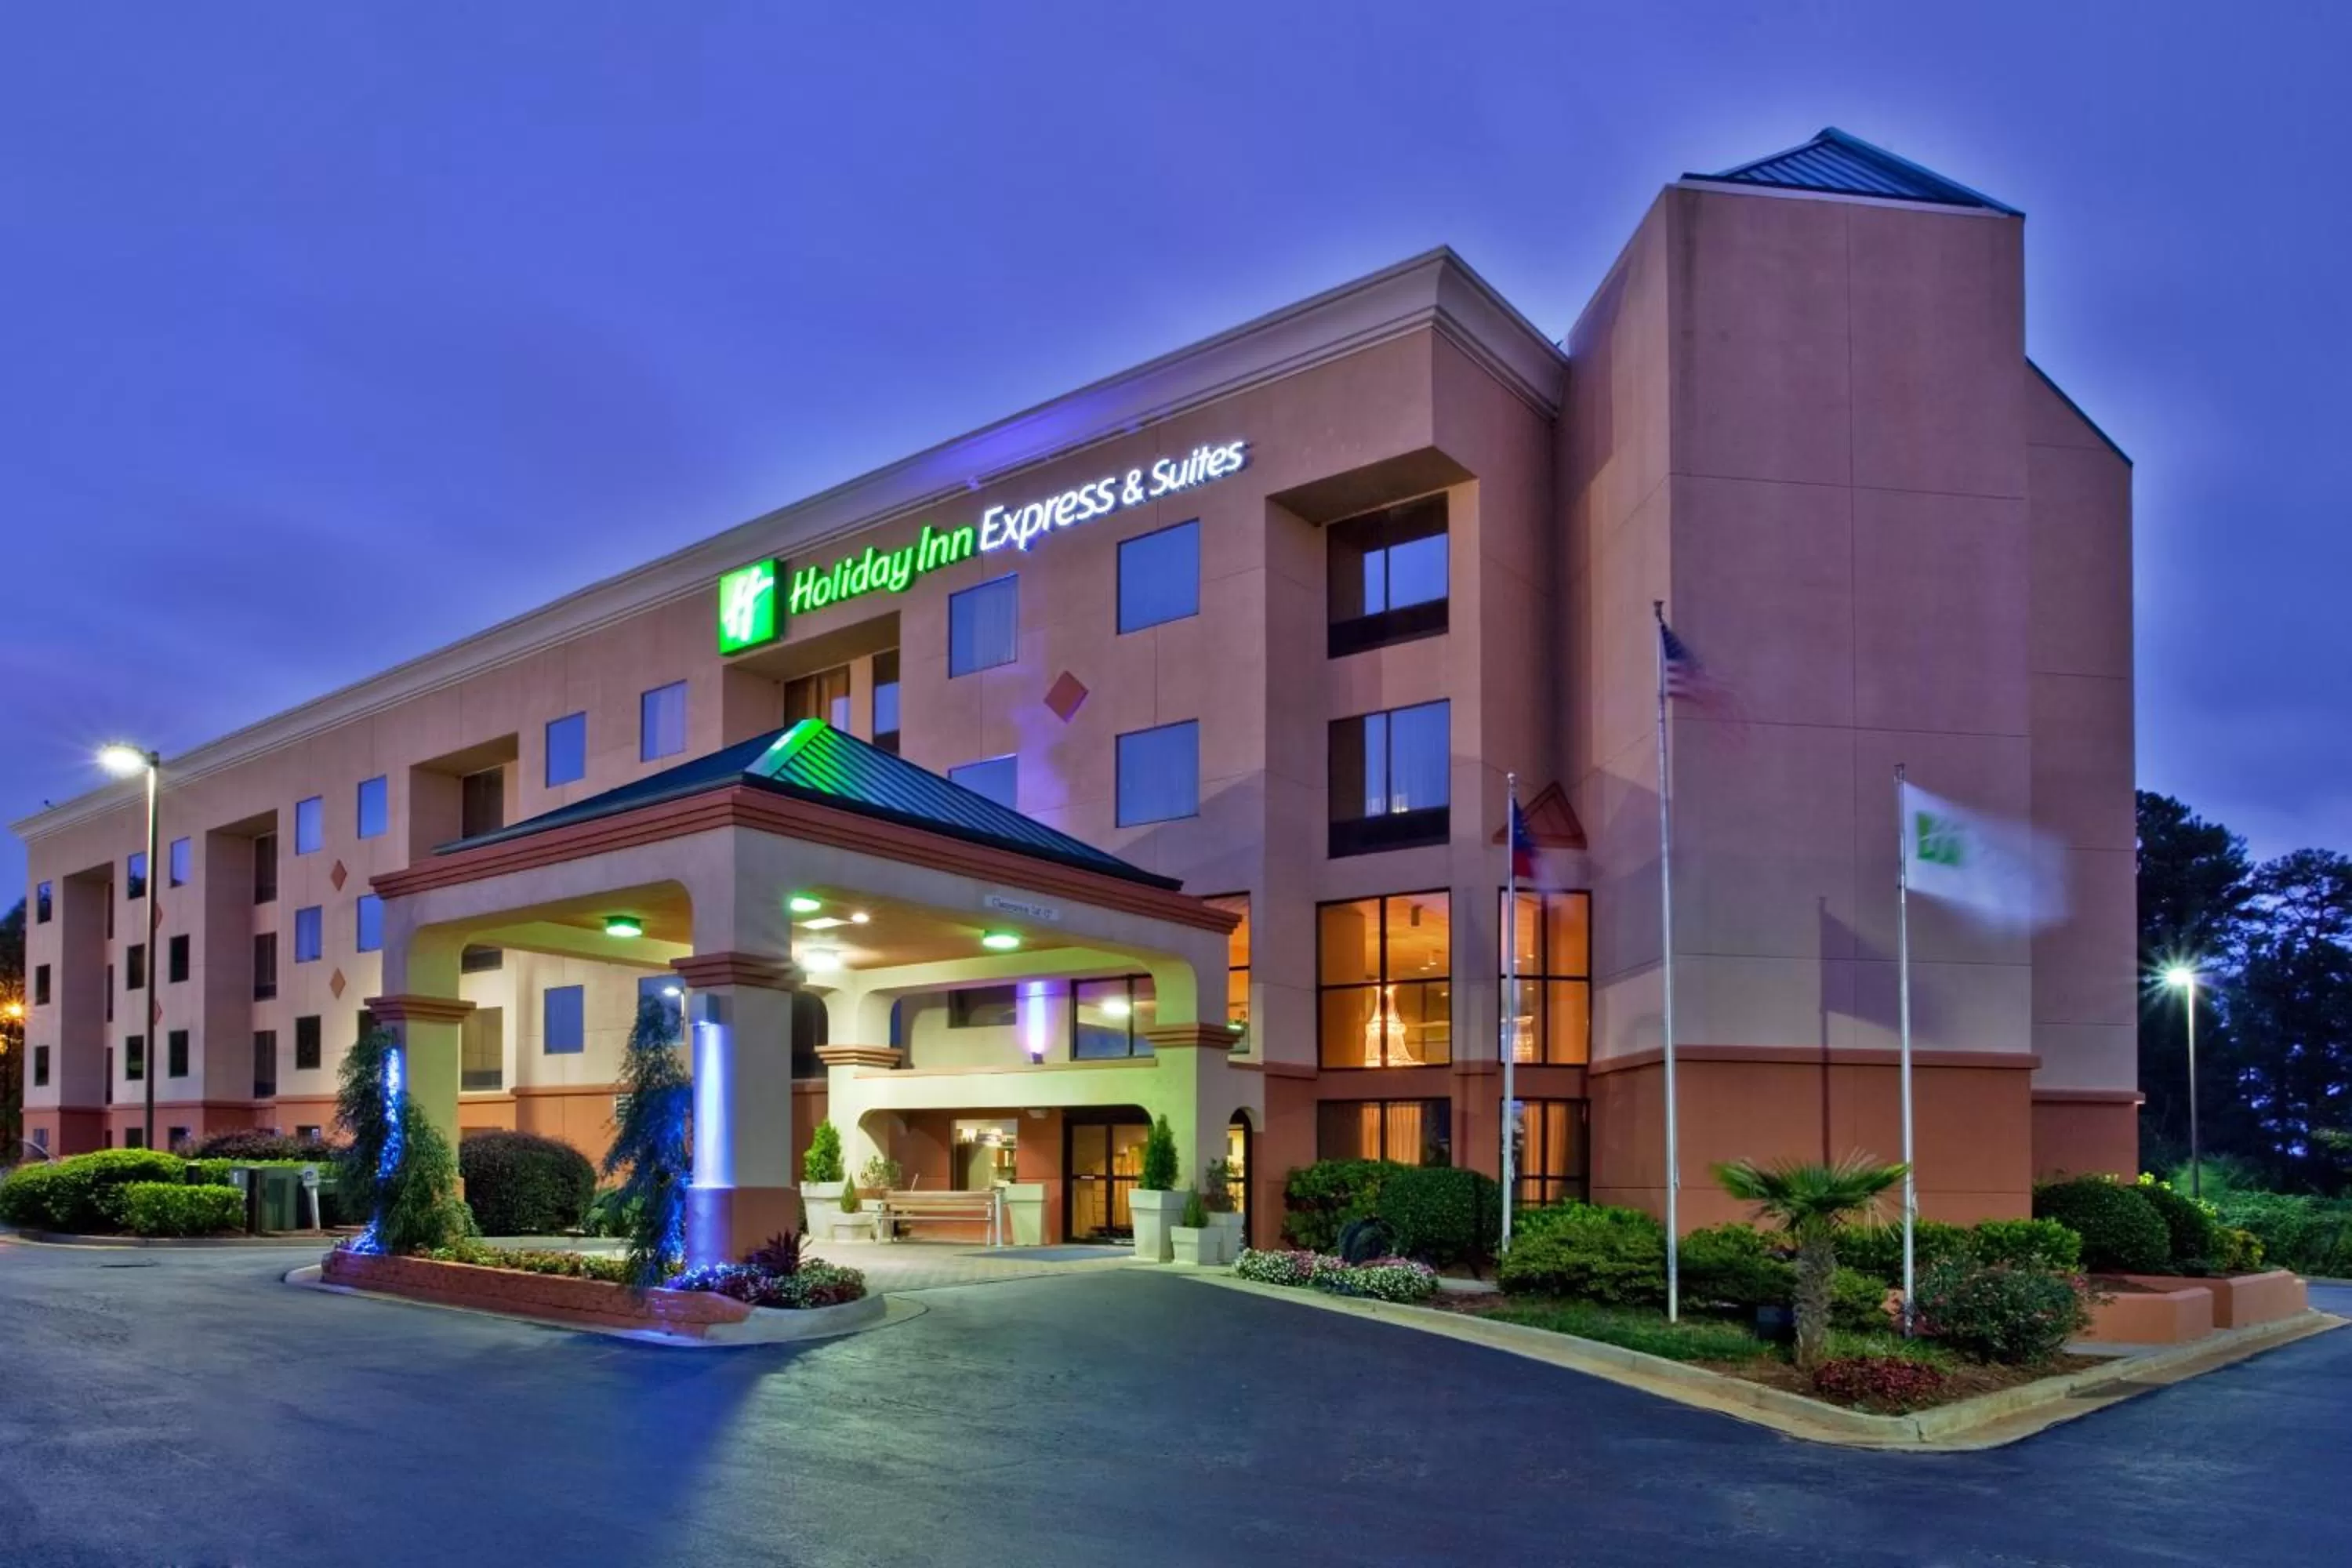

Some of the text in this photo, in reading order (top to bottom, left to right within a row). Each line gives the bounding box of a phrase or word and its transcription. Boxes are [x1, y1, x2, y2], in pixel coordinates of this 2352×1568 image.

[789, 441, 1245, 613] Holiday Inn Express & Suites
